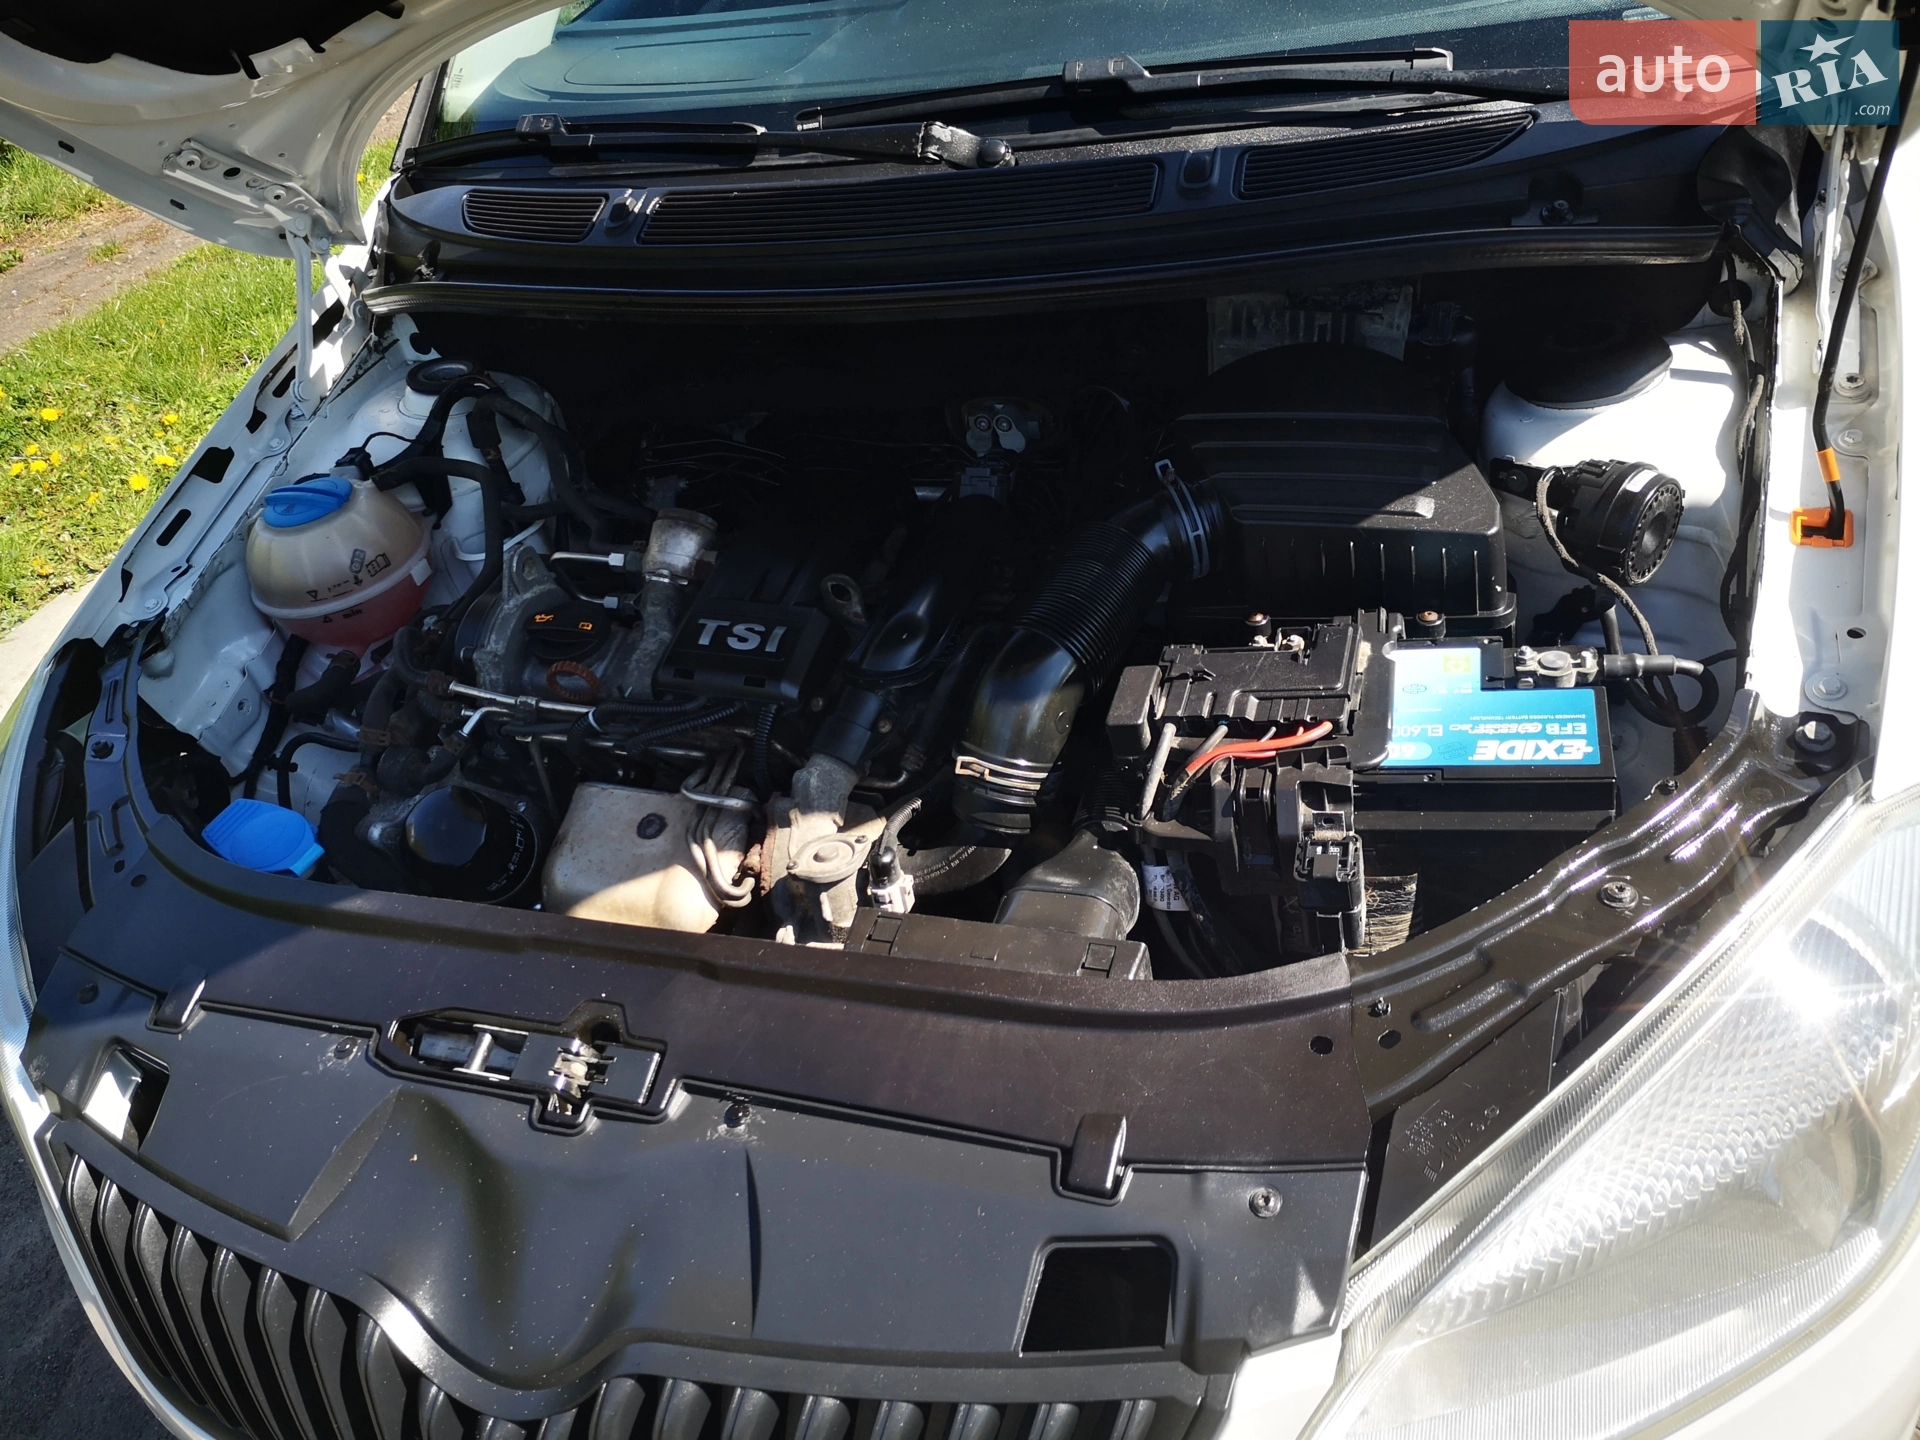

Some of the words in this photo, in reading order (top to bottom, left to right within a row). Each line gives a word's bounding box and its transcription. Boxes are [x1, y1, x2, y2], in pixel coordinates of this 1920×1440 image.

[697, 618, 787, 653] TSI
[1545, 722, 1587, 735] EFB
[1472, 739, 1594, 760] EXIDE
